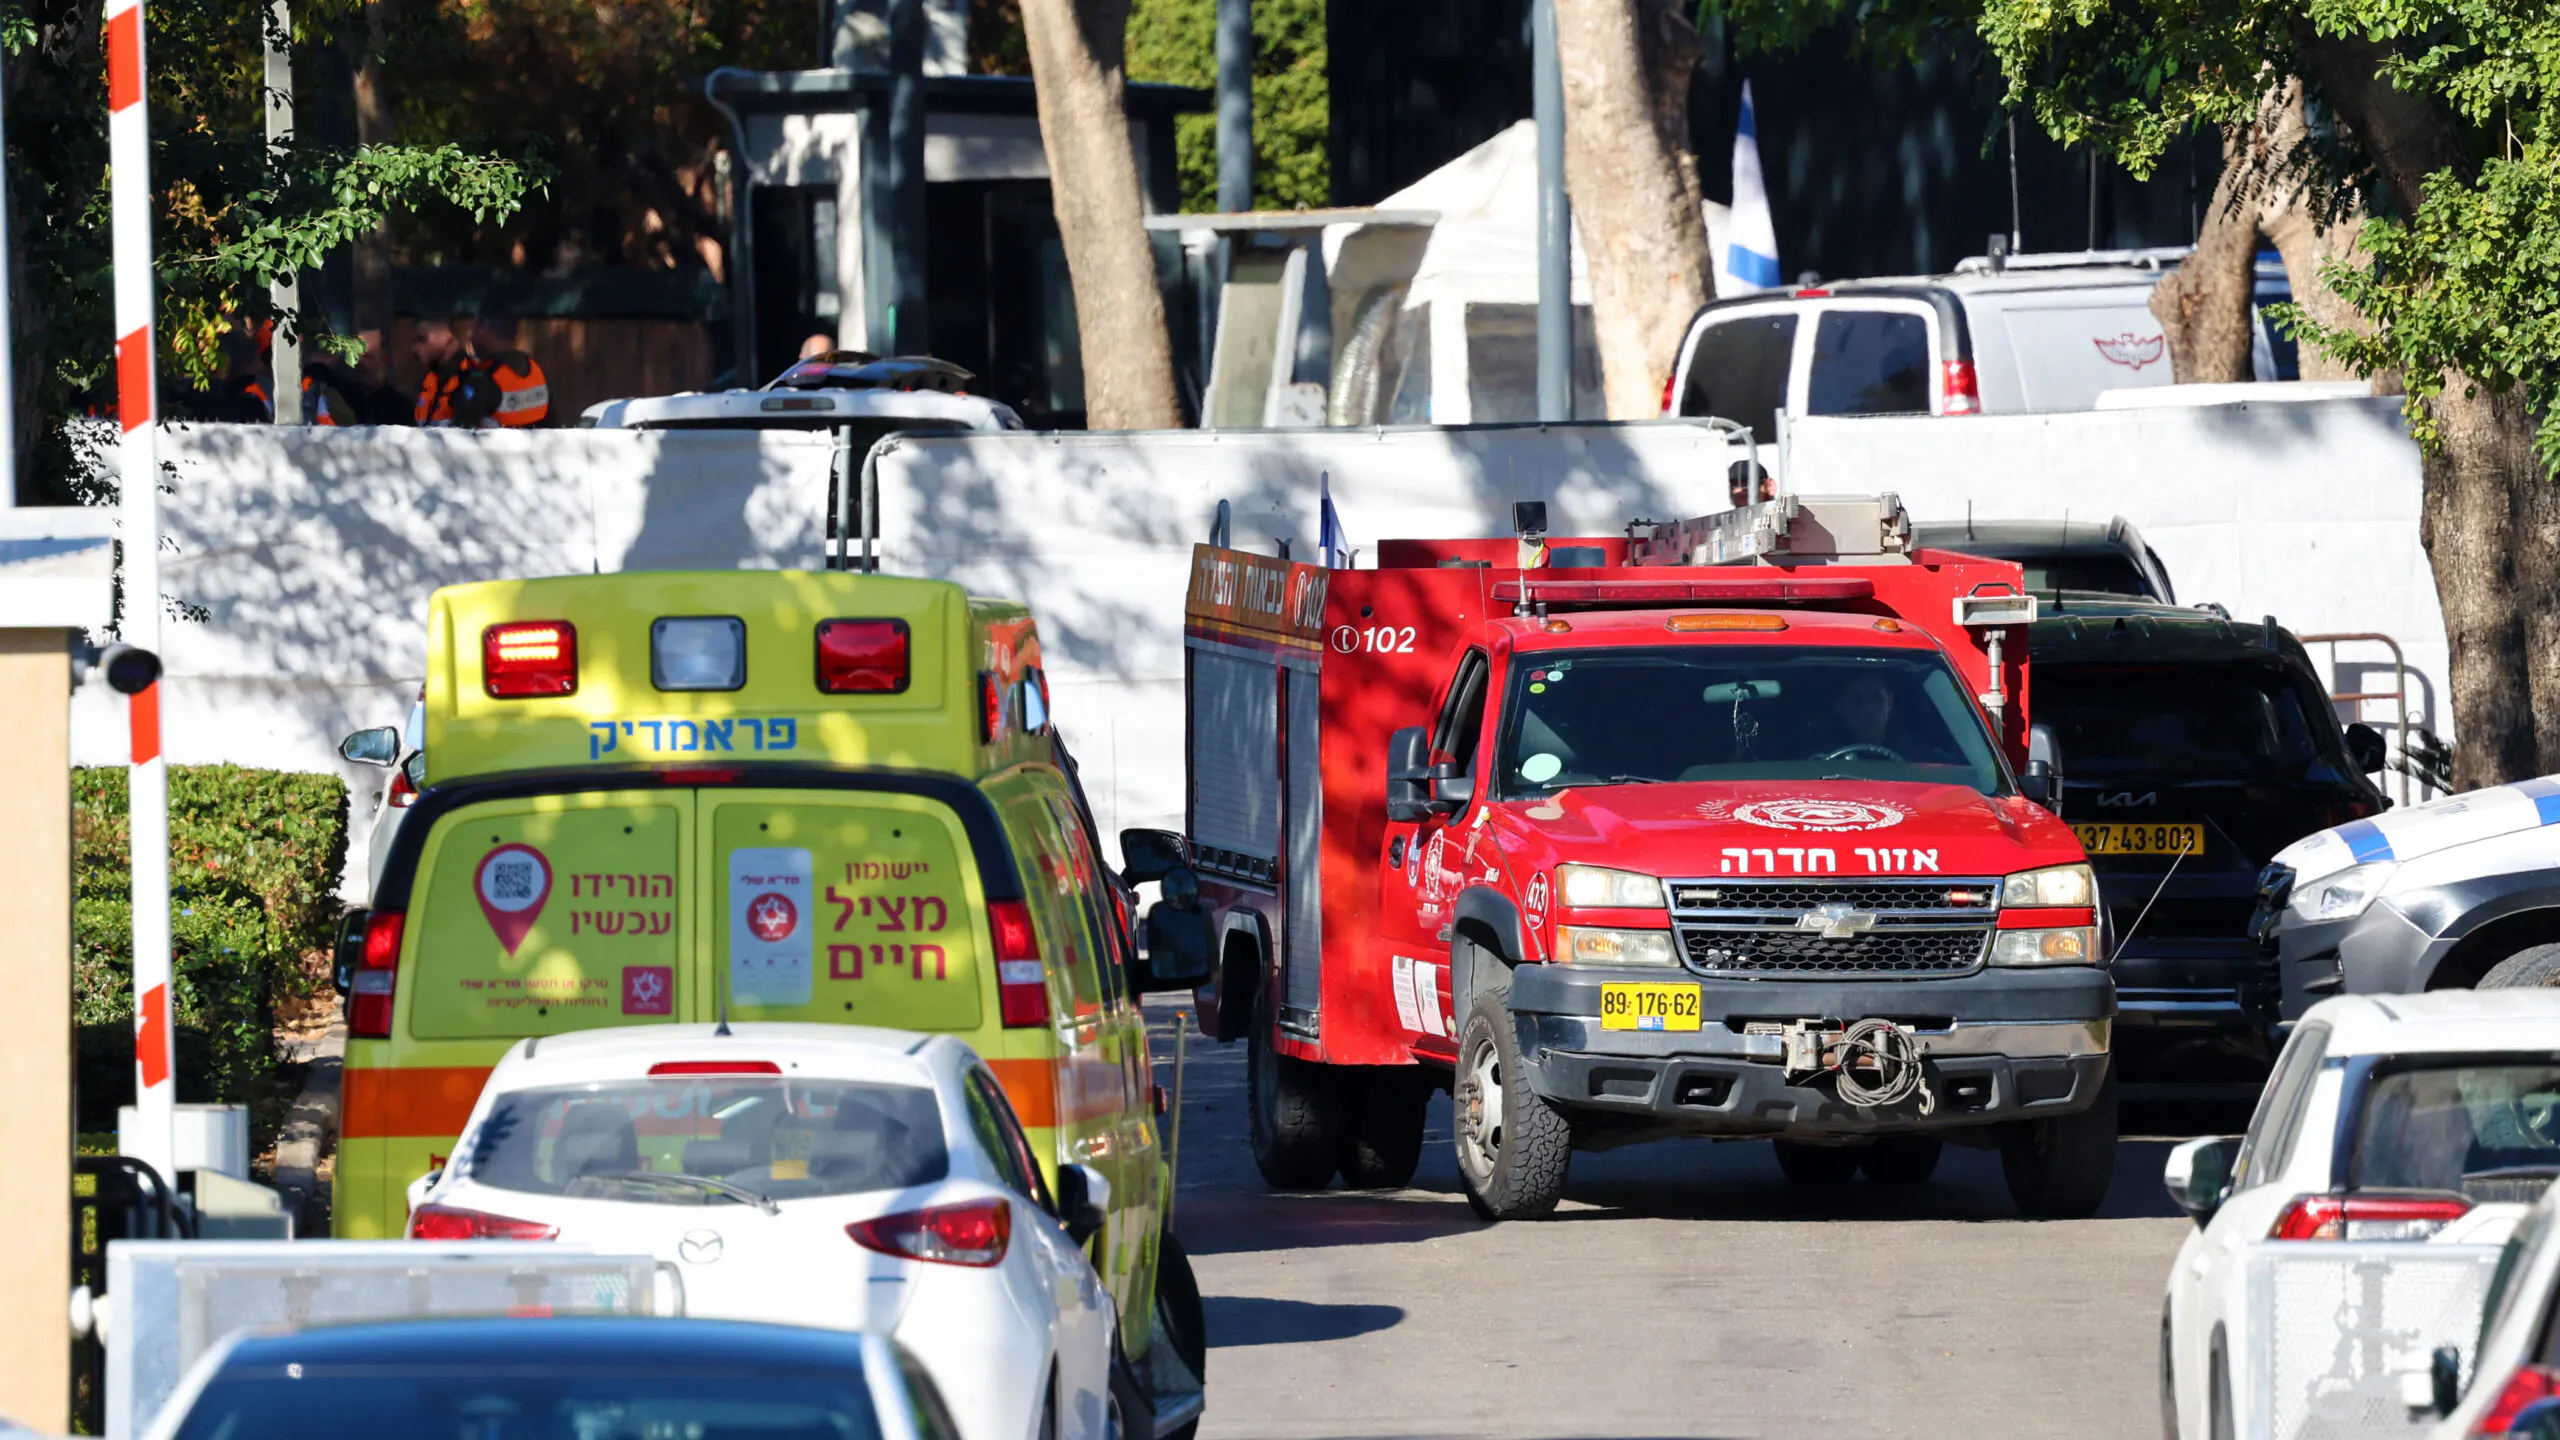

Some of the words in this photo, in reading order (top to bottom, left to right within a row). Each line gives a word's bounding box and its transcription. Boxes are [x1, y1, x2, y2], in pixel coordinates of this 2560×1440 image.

[1197, 553, 1239, 606] והצלה
[1242, 564, 1286, 614] כבאות
[1304, 576, 1327, 629] 102
[1362, 626, 1416, 653] 102
[589, 717, 798, 760] פראמדיק
[845, 861, 930, 885] יישומון
[1720, 847, 1837, 874] חדרה
[1854, 847, 1942, 872] אזור
[570, 873, 674, 899] הורידו
[1527, 881, 1547, 912] 473
[569, 910, 672, 936] עכשיו
[825, 885, 948, 932] מציל
[827, 943, 946, 981] חיים
